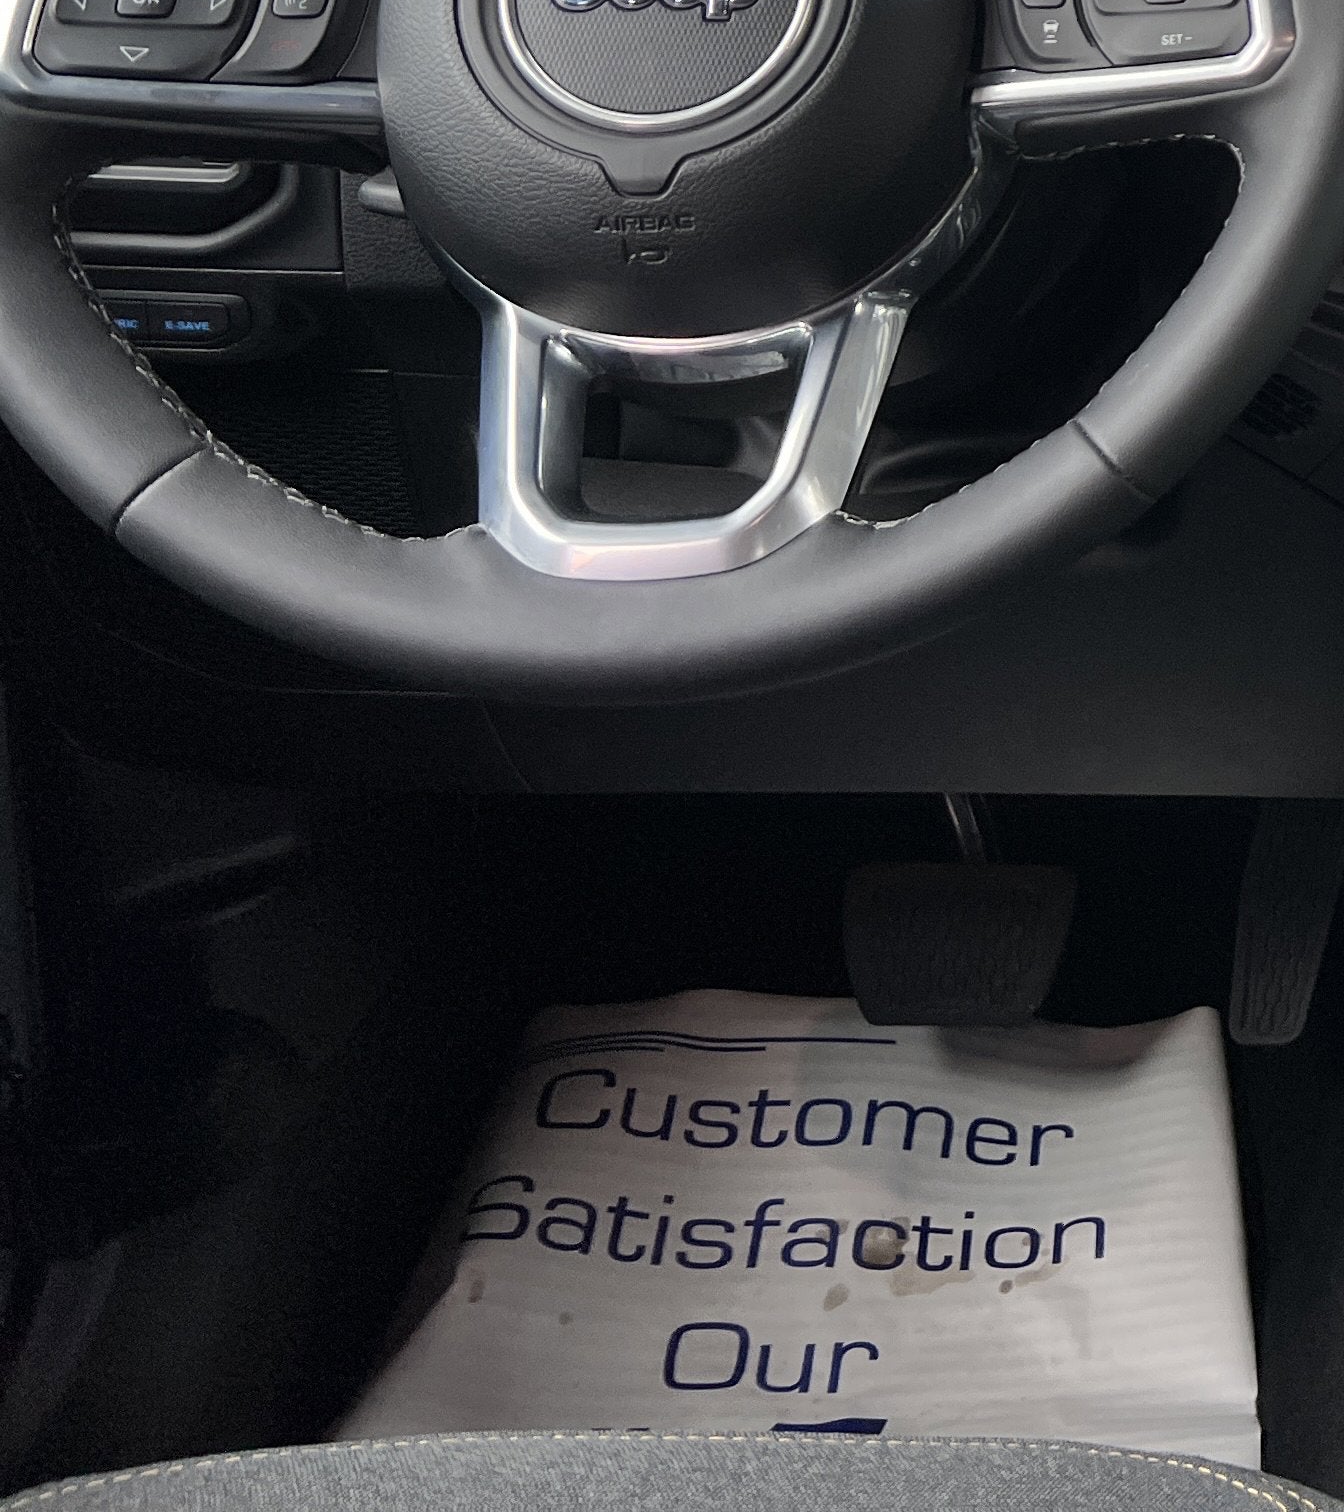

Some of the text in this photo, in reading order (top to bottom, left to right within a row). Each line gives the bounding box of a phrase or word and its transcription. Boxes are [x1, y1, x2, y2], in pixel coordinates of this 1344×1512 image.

[594, 214, 696, 233] AIRBAG
[534, 1068, 1075, 1168] Customer
[458, 1174, 1107, 1272] Satisfaction
[662, 1321, 880, 1395] Our
